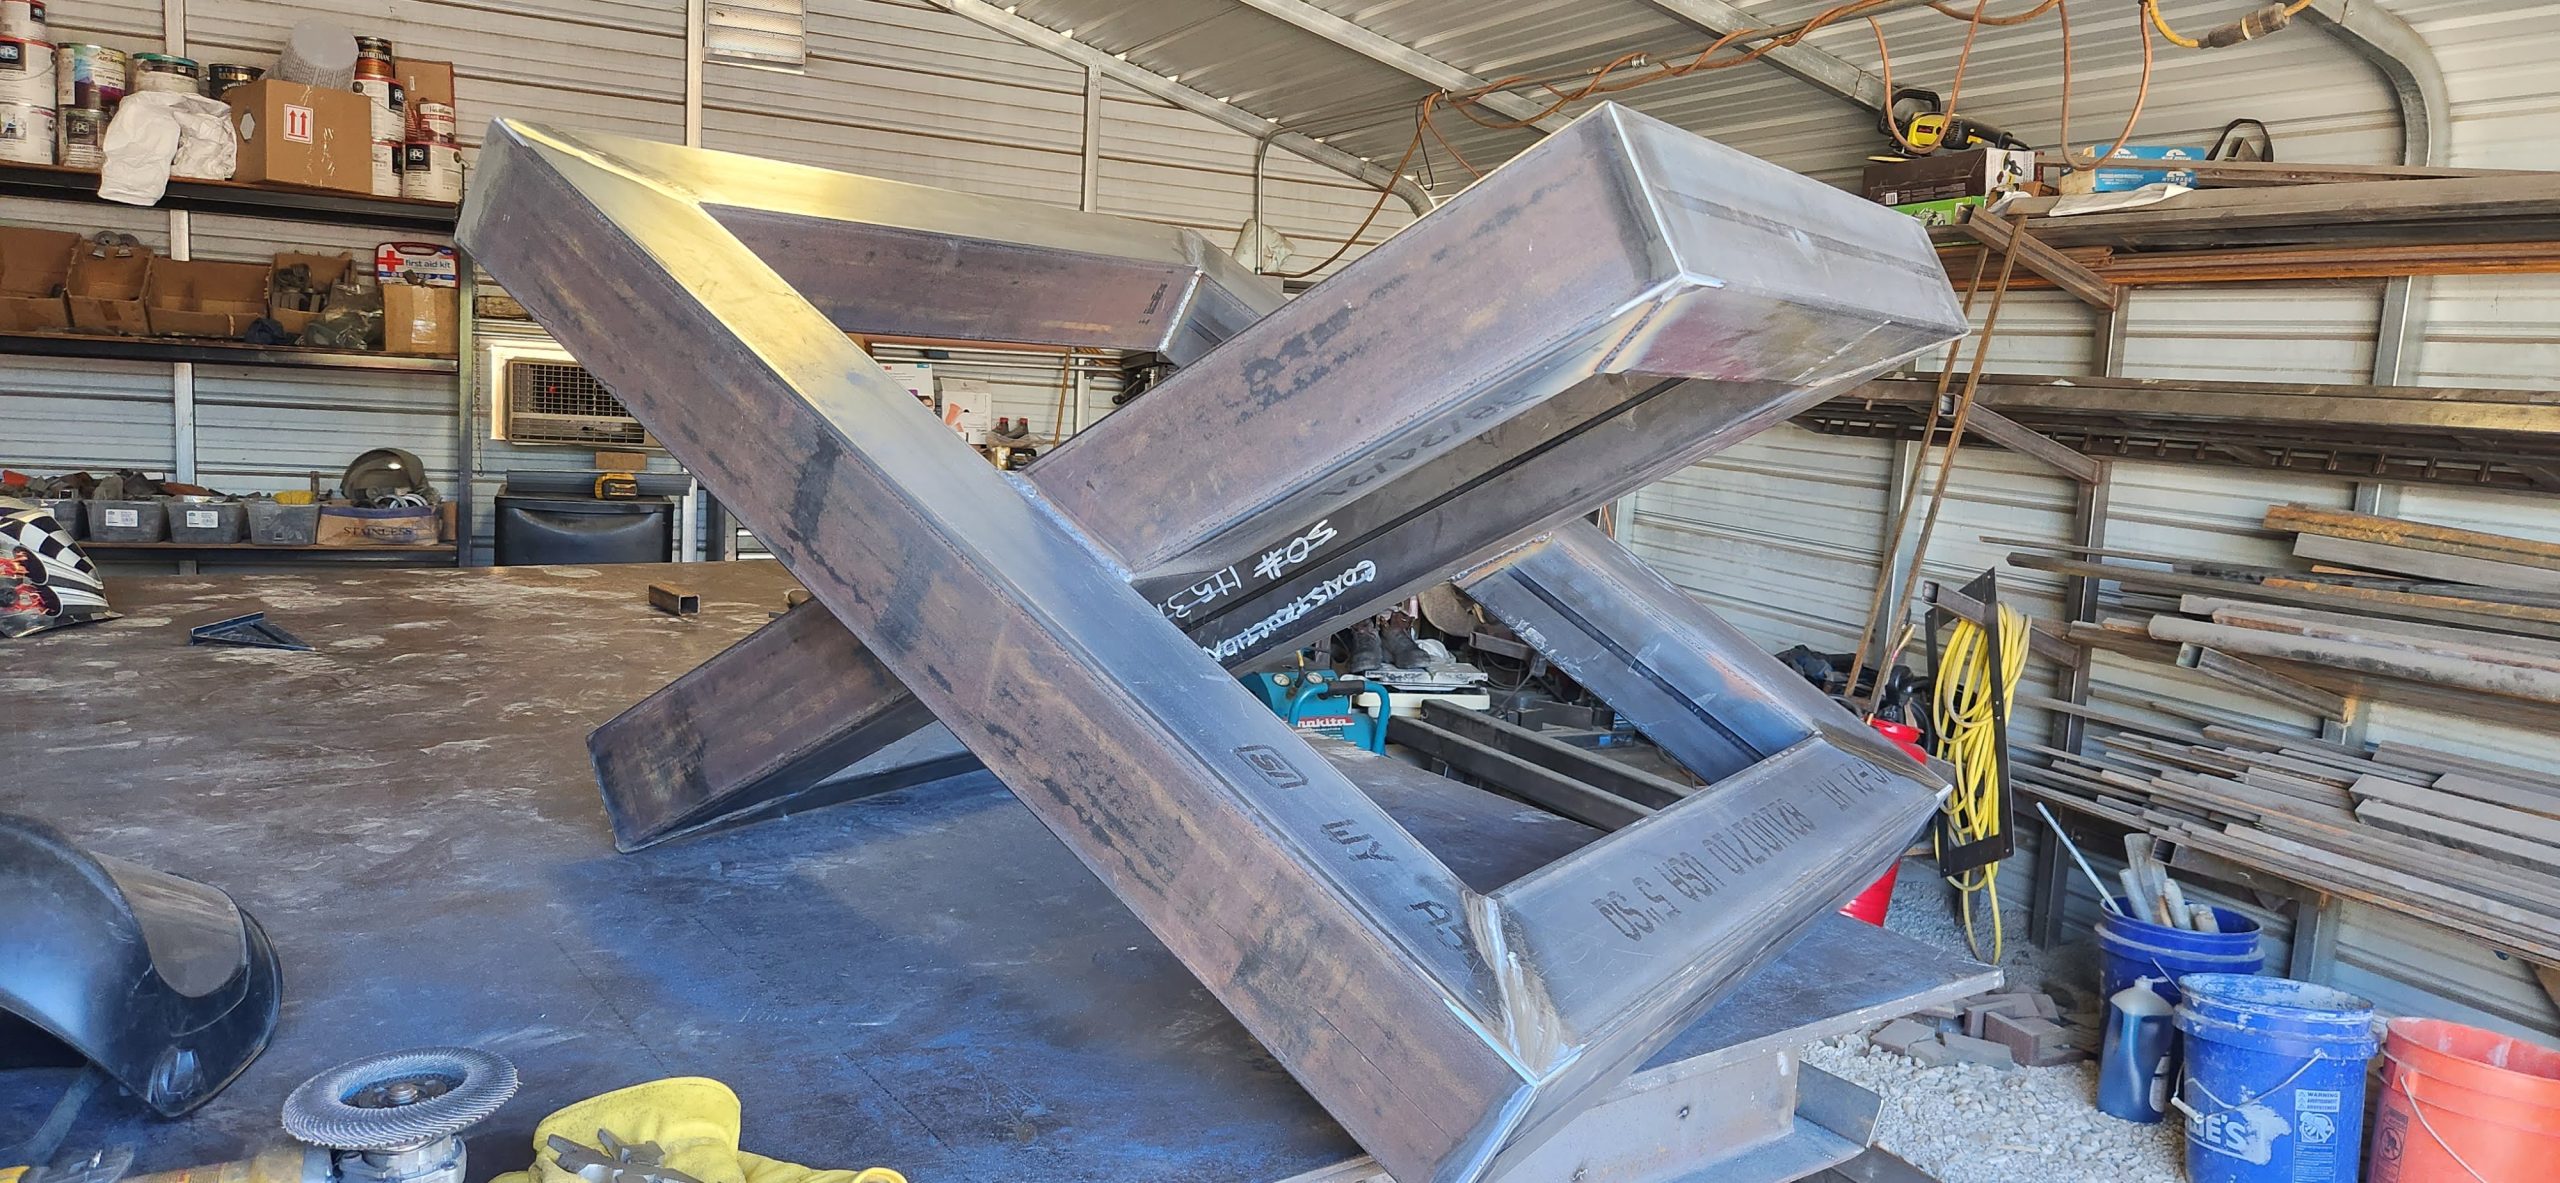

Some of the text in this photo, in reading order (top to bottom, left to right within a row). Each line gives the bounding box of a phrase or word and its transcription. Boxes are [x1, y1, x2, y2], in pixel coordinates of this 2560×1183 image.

[405, 259, 421, 267] first
[424, 260, 437, 268] aid
[343, 527, 413, 537] STAINLESS
[1253, 519, 1338, 580] SO#
[1320, 818, 1396, 862] WY
[1654, 852, 1726, 902] USA
